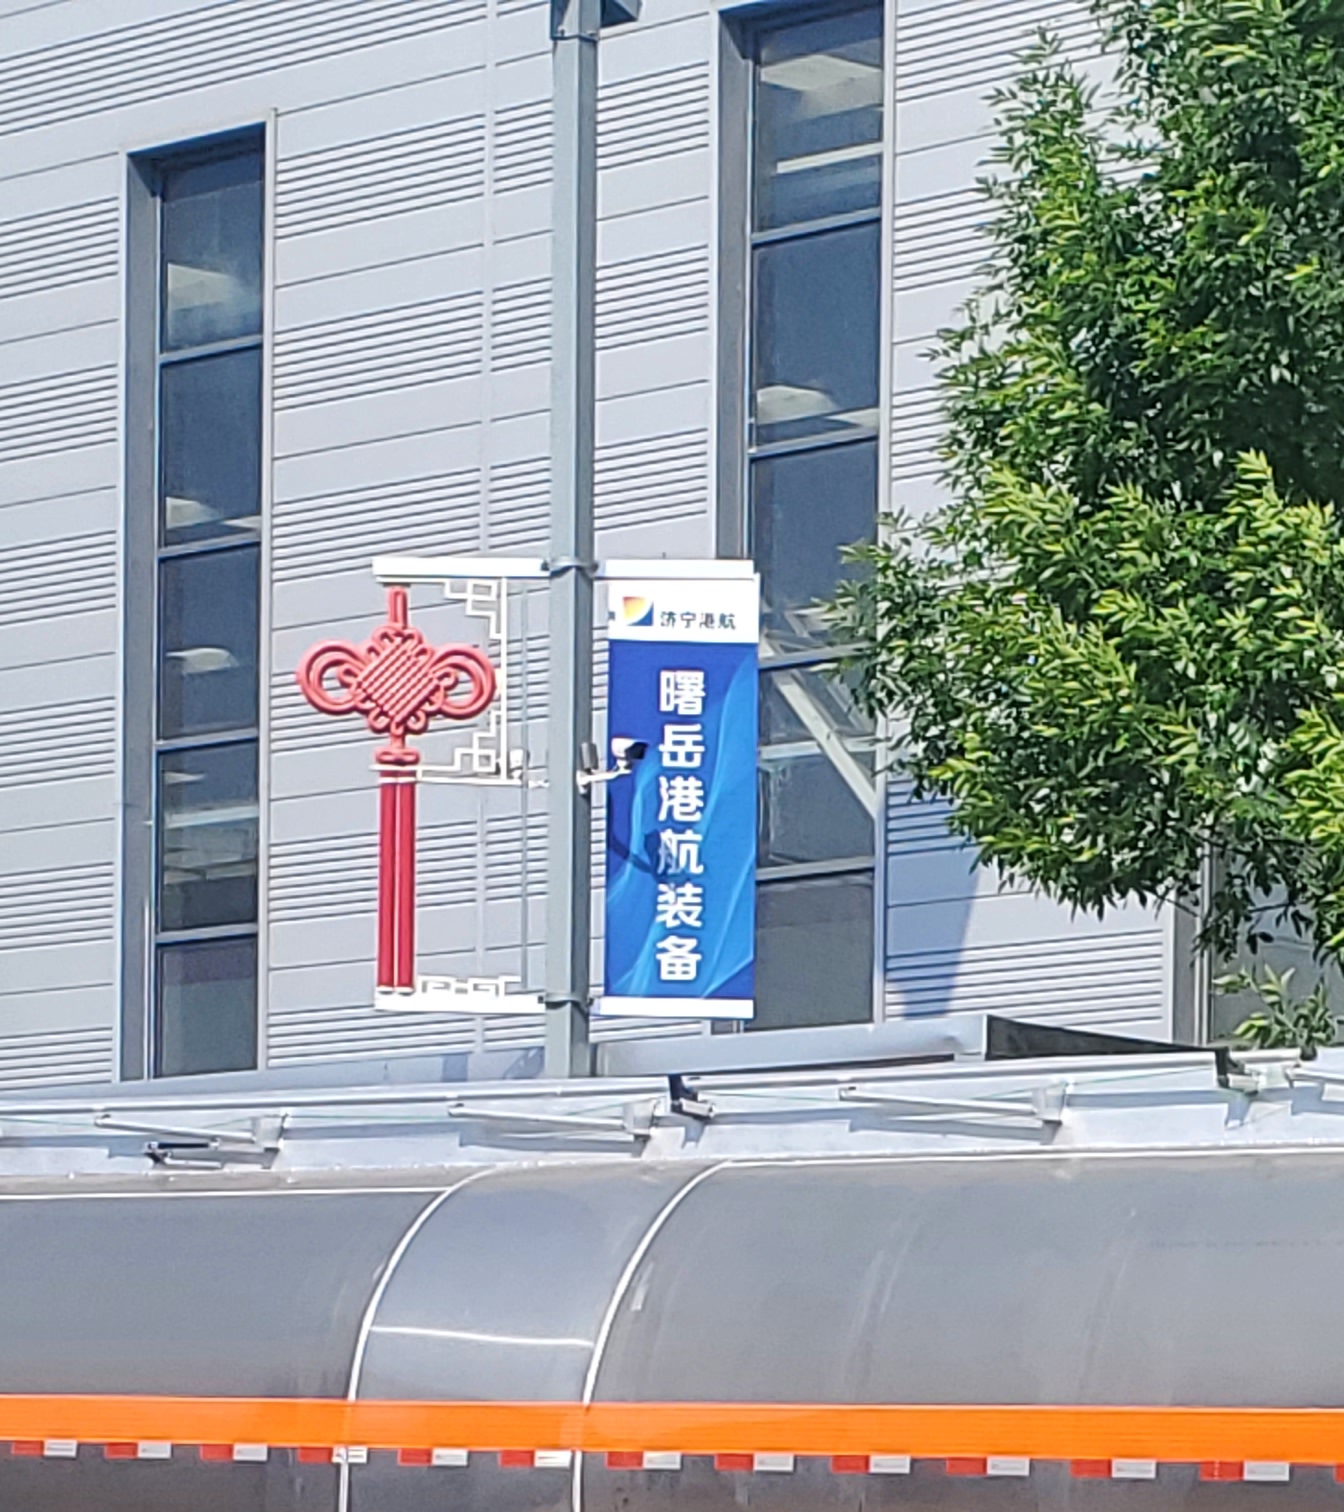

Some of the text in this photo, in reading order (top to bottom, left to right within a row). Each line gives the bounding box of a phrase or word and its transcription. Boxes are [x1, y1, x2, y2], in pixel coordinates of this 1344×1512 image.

[660, 611, 736, 630] 济宁港航
[656, 670, 706, 982] 曙岳港航装备
